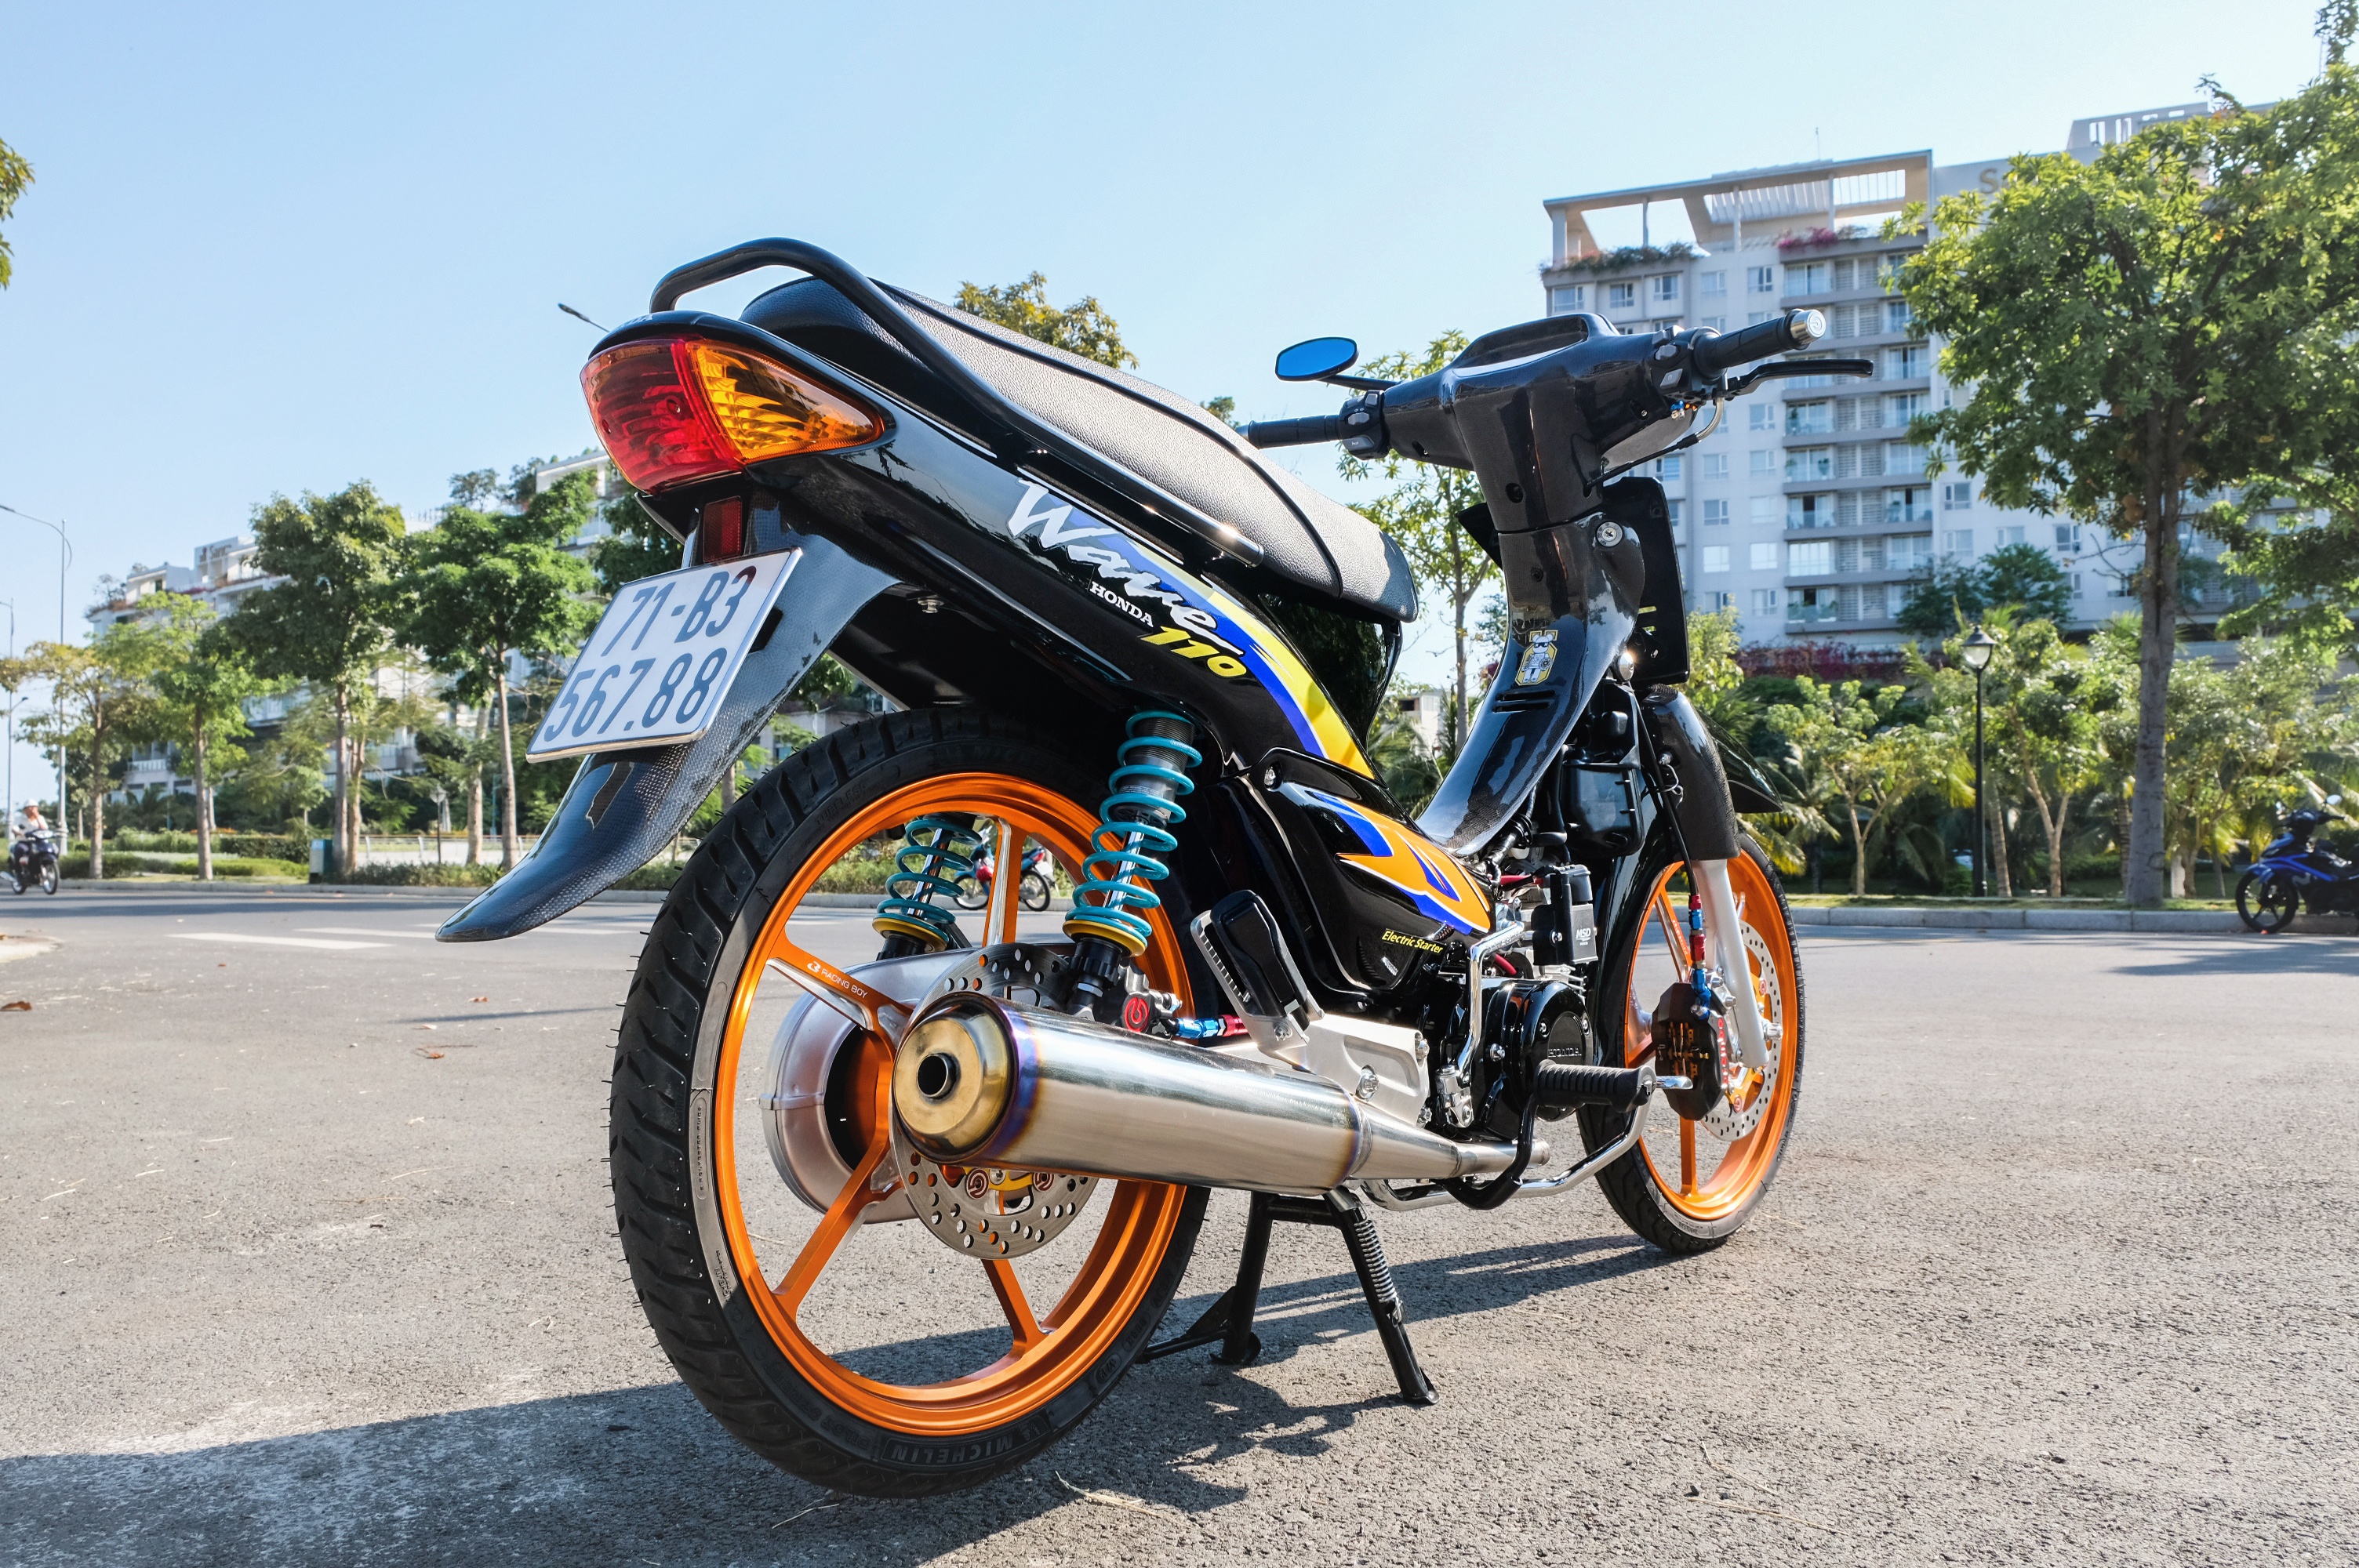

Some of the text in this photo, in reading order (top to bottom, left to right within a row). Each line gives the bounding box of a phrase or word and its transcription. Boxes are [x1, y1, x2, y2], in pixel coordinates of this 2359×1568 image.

[1008, 478, 1245, 656] Wave
[601, 565, 757, 657] 71-B3
[1089, 581, 1154, 627] HONDA
[1140, 626, 1247, 677] 110
[543, 648, 728, 742] 567.88
[1382, 931, 1443, 953] Electric Starter
[1576, 928, 1591, 939] MSD
[821, 968, 867, 998] RACING BOY
[1547, 1047, 1582, 1058] HONDA
[891, 1434, 1014, 1464] MICHELIN
